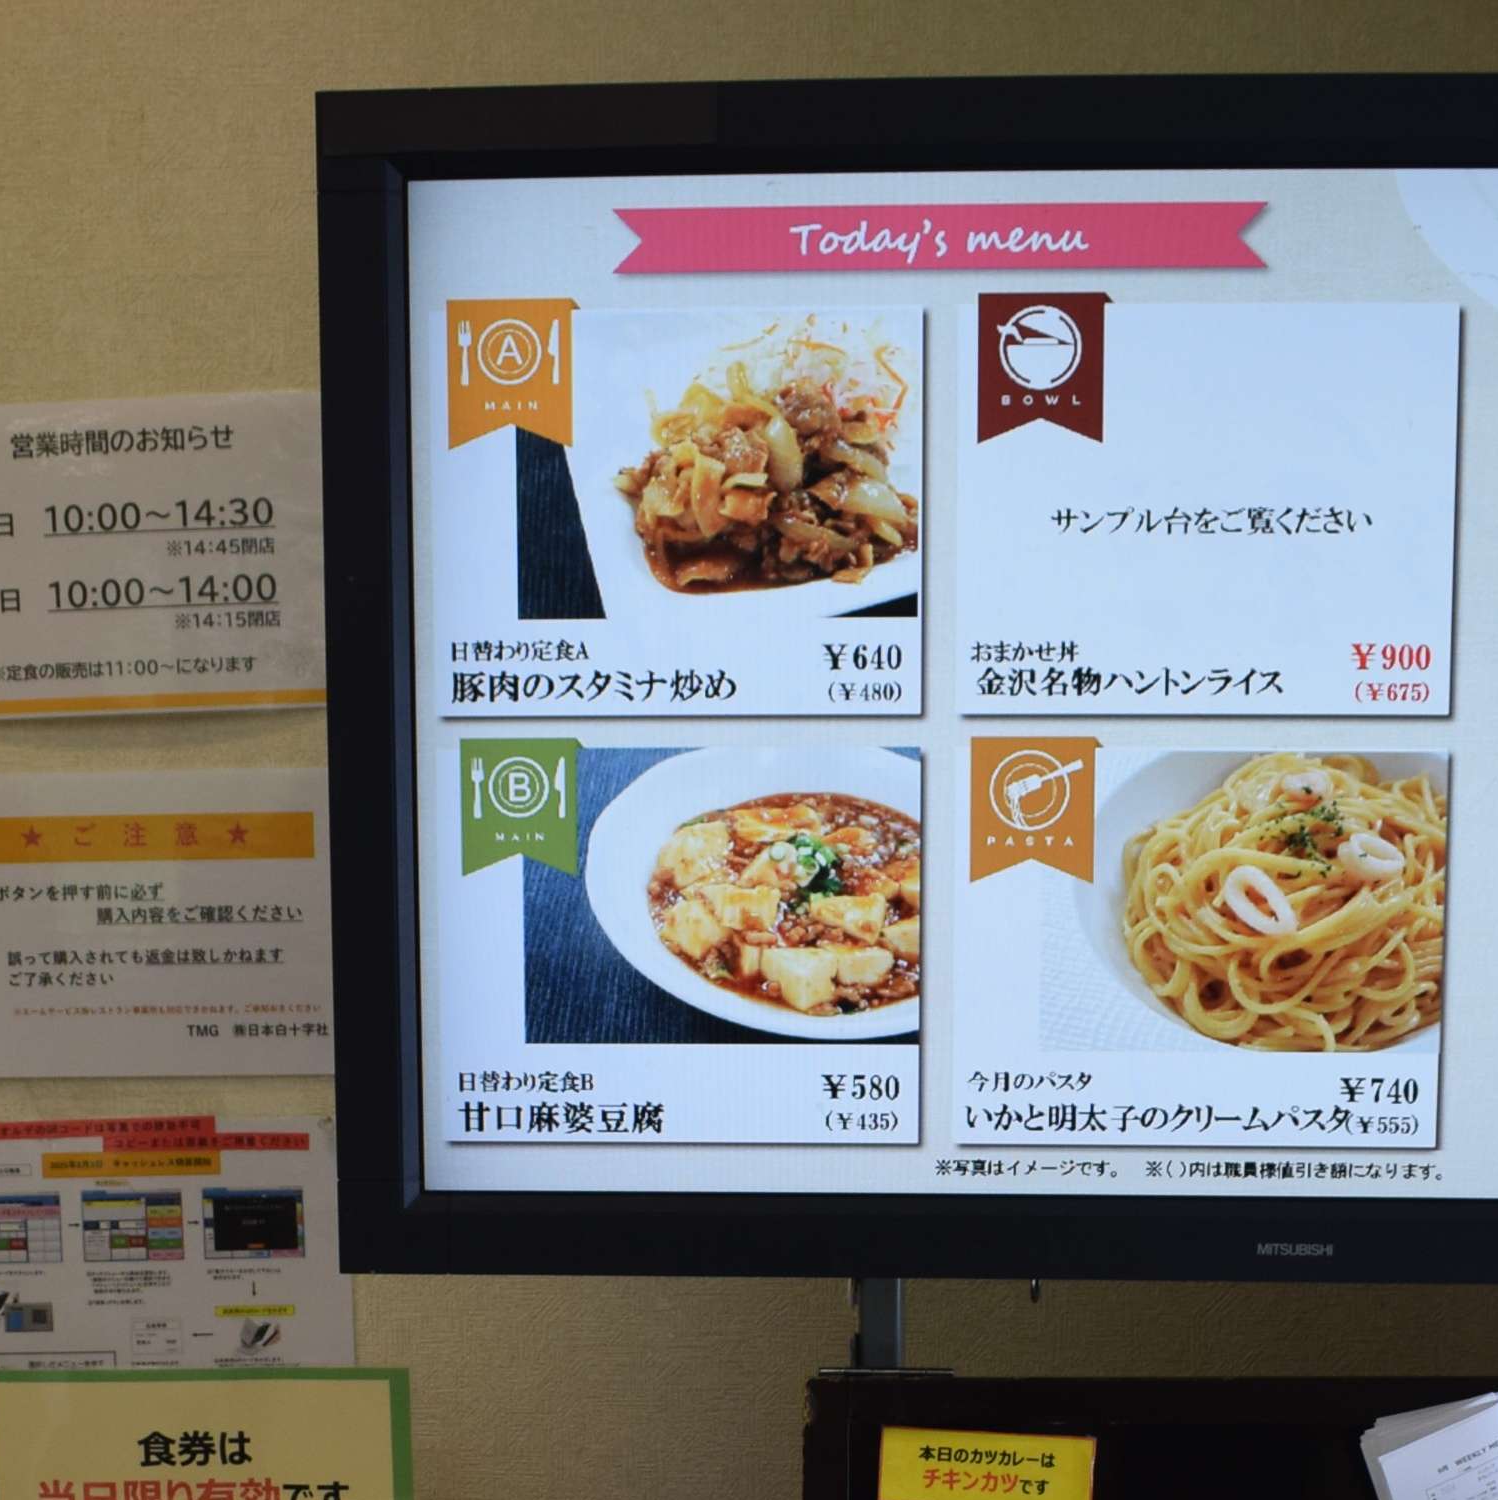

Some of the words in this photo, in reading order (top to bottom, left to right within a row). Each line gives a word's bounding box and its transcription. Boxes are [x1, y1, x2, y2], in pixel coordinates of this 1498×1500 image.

[789, 219, 947, 264] Today's
[966, 225, 1089, 254] menu
[495, 334, 524, 366] A
[484, 401, 540, 411] MAIN
[1000, 394, 1081, 406] BOWL
[9, 424, 235, 460] 営業時間のお知らせ
[1051, 506, 1374, 536] サンプル台をご覧ください
[451, 638, 590, 662] 日替わり定食A
[822, 643, 903, 671] ¥640
[970, 640, 1079, 664] おまかせ丼
[1350, 643, 1433, 671] ¥900
[451, 668, 737, 704] 豚肉のスタミナ炒め
[827, 681, 903, 705] (¥480)
[975, 666, 1285, 698] 金沢名物ハントンライス
[1354, 681, 1431, 703] (¥675)
[508, 771, 532, 798] B
[495, 832, 545, 841] MAIN
[986, 836, 1074, 847] PASTA
[96, 905, 303, 926] 購入内容をご確認ください
[7, 947, 285, 968] 誤って購入されても返金は致しかねます
[8, 969, 115, 988] ご了承ください
[187, 1024, 220, 1038] TMG
[458, 1070, 594, 1093] 日替わり定食B
[821, 1073, 900, 1100] ¥580
[967, 1071, 1093, 1093] 今月のパスタ
[1340, 1076, 1419, 1105] ¥740
[458, 1101, 665, 1135] 甘口麻婆豆腐
[824, 1111, 900, 1133] (¥435)
[964, 1102, 1349, 1135] いかと明太子のクリームパスタ
[1345, 1114, 1420, 1137] (¥555)
[935, 1158, 1120, 1179] ※写真はイメージです。
[1256, 1242, 1334, 1257] MITSUBISHI
[137, 1430, 253, 1468] 食券は
[918, 1445, 1056, 1468] 本日のカツカレーは
[922, 1468, 1050, 1496] チキンカツです
